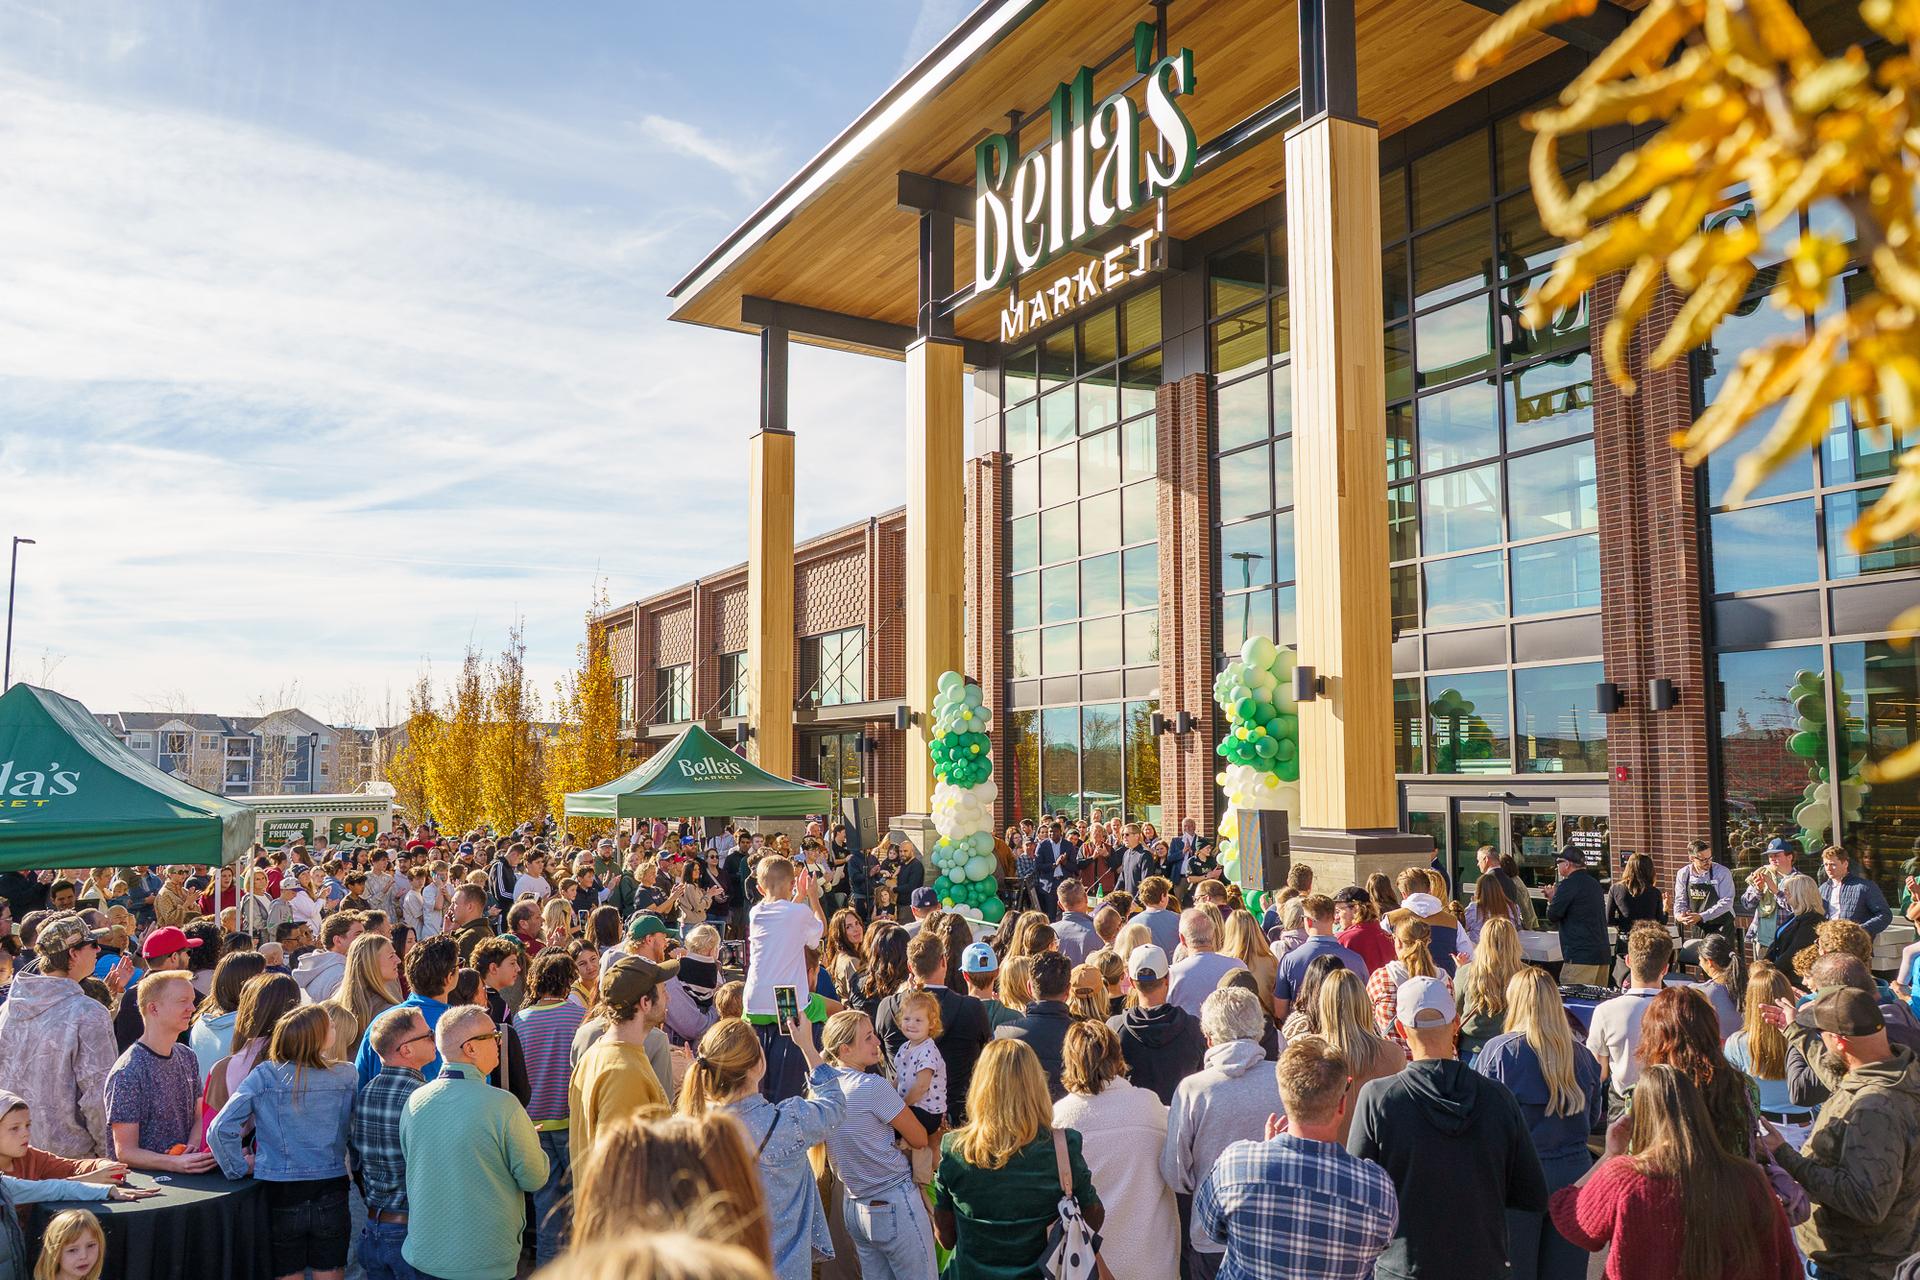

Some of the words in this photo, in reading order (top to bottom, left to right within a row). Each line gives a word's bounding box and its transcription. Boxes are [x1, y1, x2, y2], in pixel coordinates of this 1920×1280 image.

[976, 21, 1197, 294] Bella's
[1000, 228, 1159, 343] MARKET
[678, 756, 743, 777] Bella's
[269, 830, 304, 838] FRIEN
